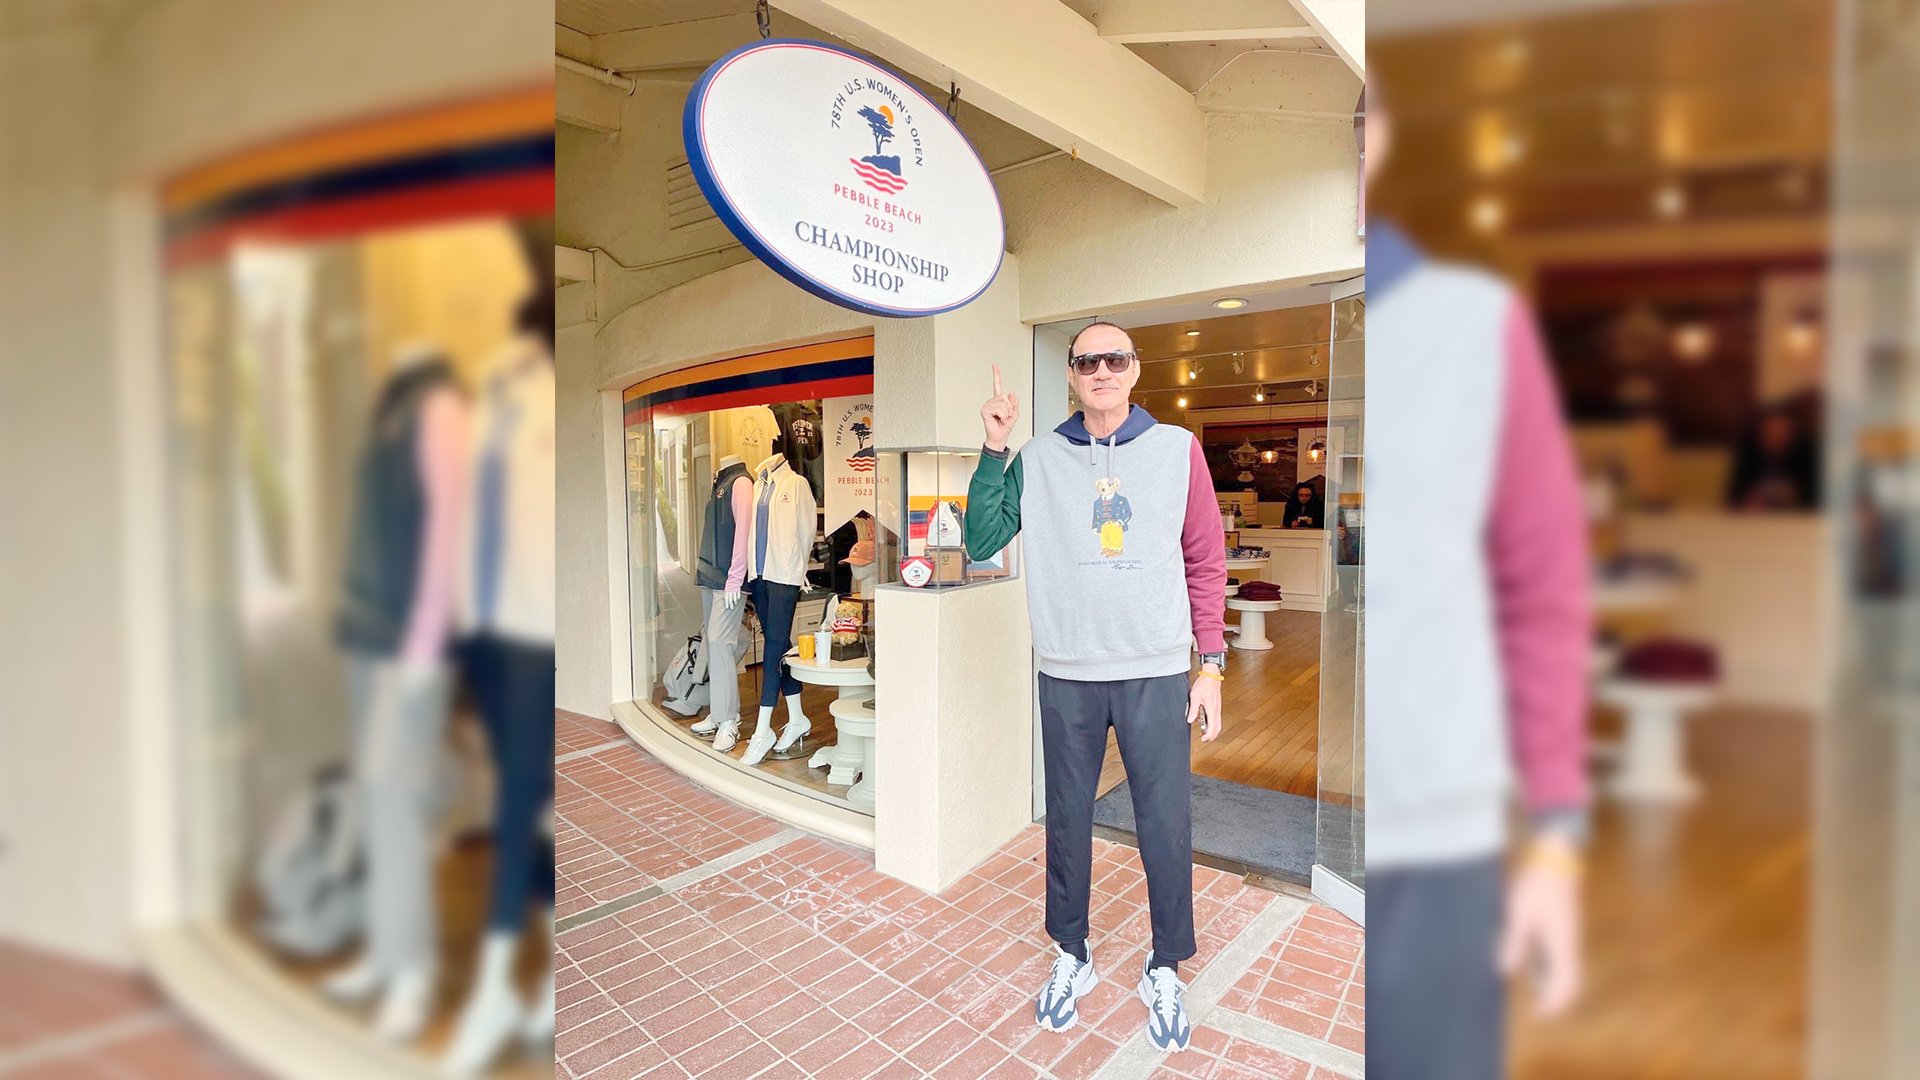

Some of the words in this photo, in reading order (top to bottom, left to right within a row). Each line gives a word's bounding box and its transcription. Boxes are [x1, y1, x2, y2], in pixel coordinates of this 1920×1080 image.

[831, 93, 847, 129] 78TH
[844, 78, 865, 95] U.S.
[866, 78, 913, 125] WOMEN'S
[910, 128, 923, 167] OPEN
[834, 183, 880, 210] PEBBLE
[884, 202, 922, 225] BEACH
[865, 214, 894, 233] 2023
[794, 220, 949, 283] CHAMPIONSHIP
[852, 263, 904, 294] SHOP
[836, 424, 844, 447] 78TH
[853, 403, 874, 412] WOME
